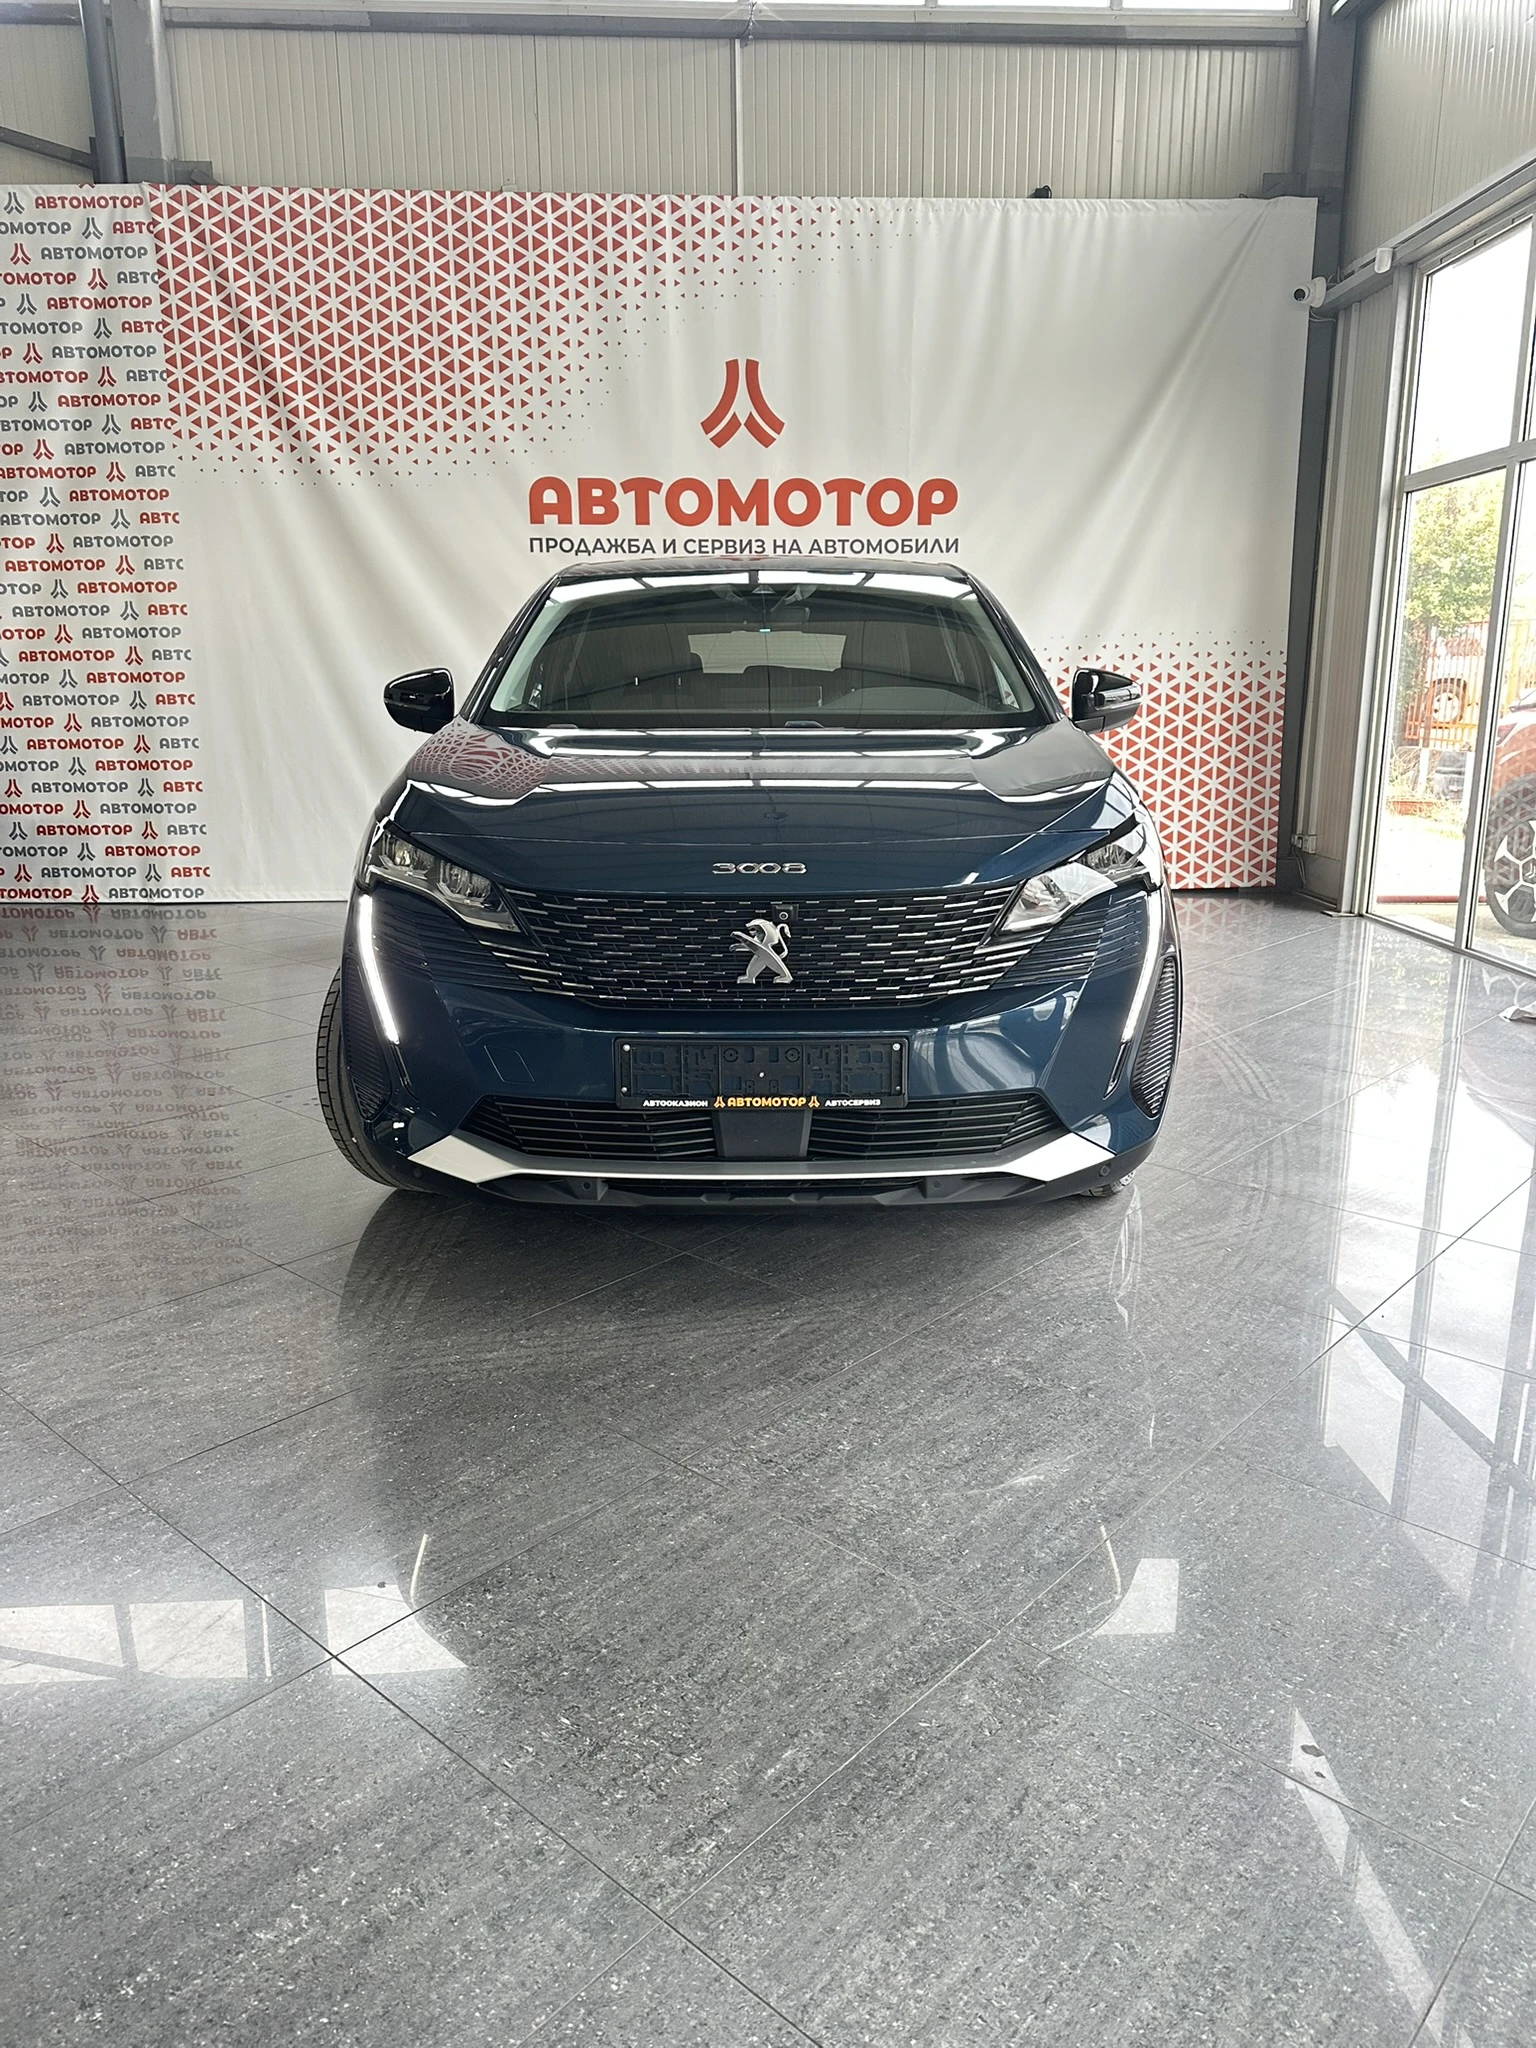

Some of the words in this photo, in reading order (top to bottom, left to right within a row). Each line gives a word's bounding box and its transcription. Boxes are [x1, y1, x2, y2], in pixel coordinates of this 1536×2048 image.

[35, 195, 144, 209] АВТОМОТОР
[41, 246, 148, 260] АВТОМОТОР
[0, 272, 76, 285] ОМОТОР
[47, 296, 152, 310] АВТОМОТОР
[52, 345, 157, 359] АВТОМОТОР
[58, 394, 161, 407] АВТОМОТОР
[65, 442, 165, 455] АВТОМОТОР
[69, 489, 169, 502] АВТОМОТОР
[529, 476, 958, 527] АВТОМОТОР
[0, 513, 101, 526] АВТОМОТОР
[0, 537, 35, 549] ТОР
[73, 535, 173, 548] АВТОМОТОР
[529, 537, 656, 555] ПРОДАЖБА
[662, 539, 677, 554] И
[684, 539, 766, 555] СЕРВИЗ
[773, 539, 802, 554] НА
[808, 538, 959, 554] АВТОМОБИЛИ
[5, 559, 105, 572] АВТОМОТОР
[77, 581, 177, 594] АВТОМОТОР
[12, 605, 110, 617] АВТОМОТОР
[0, 628, 46, 640] ОТОР
[82, 627, 181, 639] АВТОМОТОР
[19, 650, 115, 662] АВТОМОТОР
[86, 672, 185, 683] АВТОМОТОР
[22, 694, 119, 706] АВТОМОТОР
[91, 716, 189, 727] АВТОМОТОР
[27, 738, 124, 750] АВТОМОТОР
[95, 760, 193, 771] АВТОМОТОР
[31, 782, 128, 793] АВТОМОТОР
[100, 803, 197, 815] АВТОМОТОР
[37, 824, 132, 835] АВТОМОТОР
[0, 846, 68, 857] ОМОТОР
[105, 845, 201, 857] АВТОМОТОР
[41, 867, 136, 878] АВТОМОТОР
[712, 863, 807, 874] 3008
[109, 888, 205, 898] АВТОМОТОР
[643, 1100, 708, 1108] АВТООКАЗИОН
[728, 1097, 806, 1108] АВТОМОТОР
[825, 1099, 880, 1107] АВТОСЕРВИЗ
